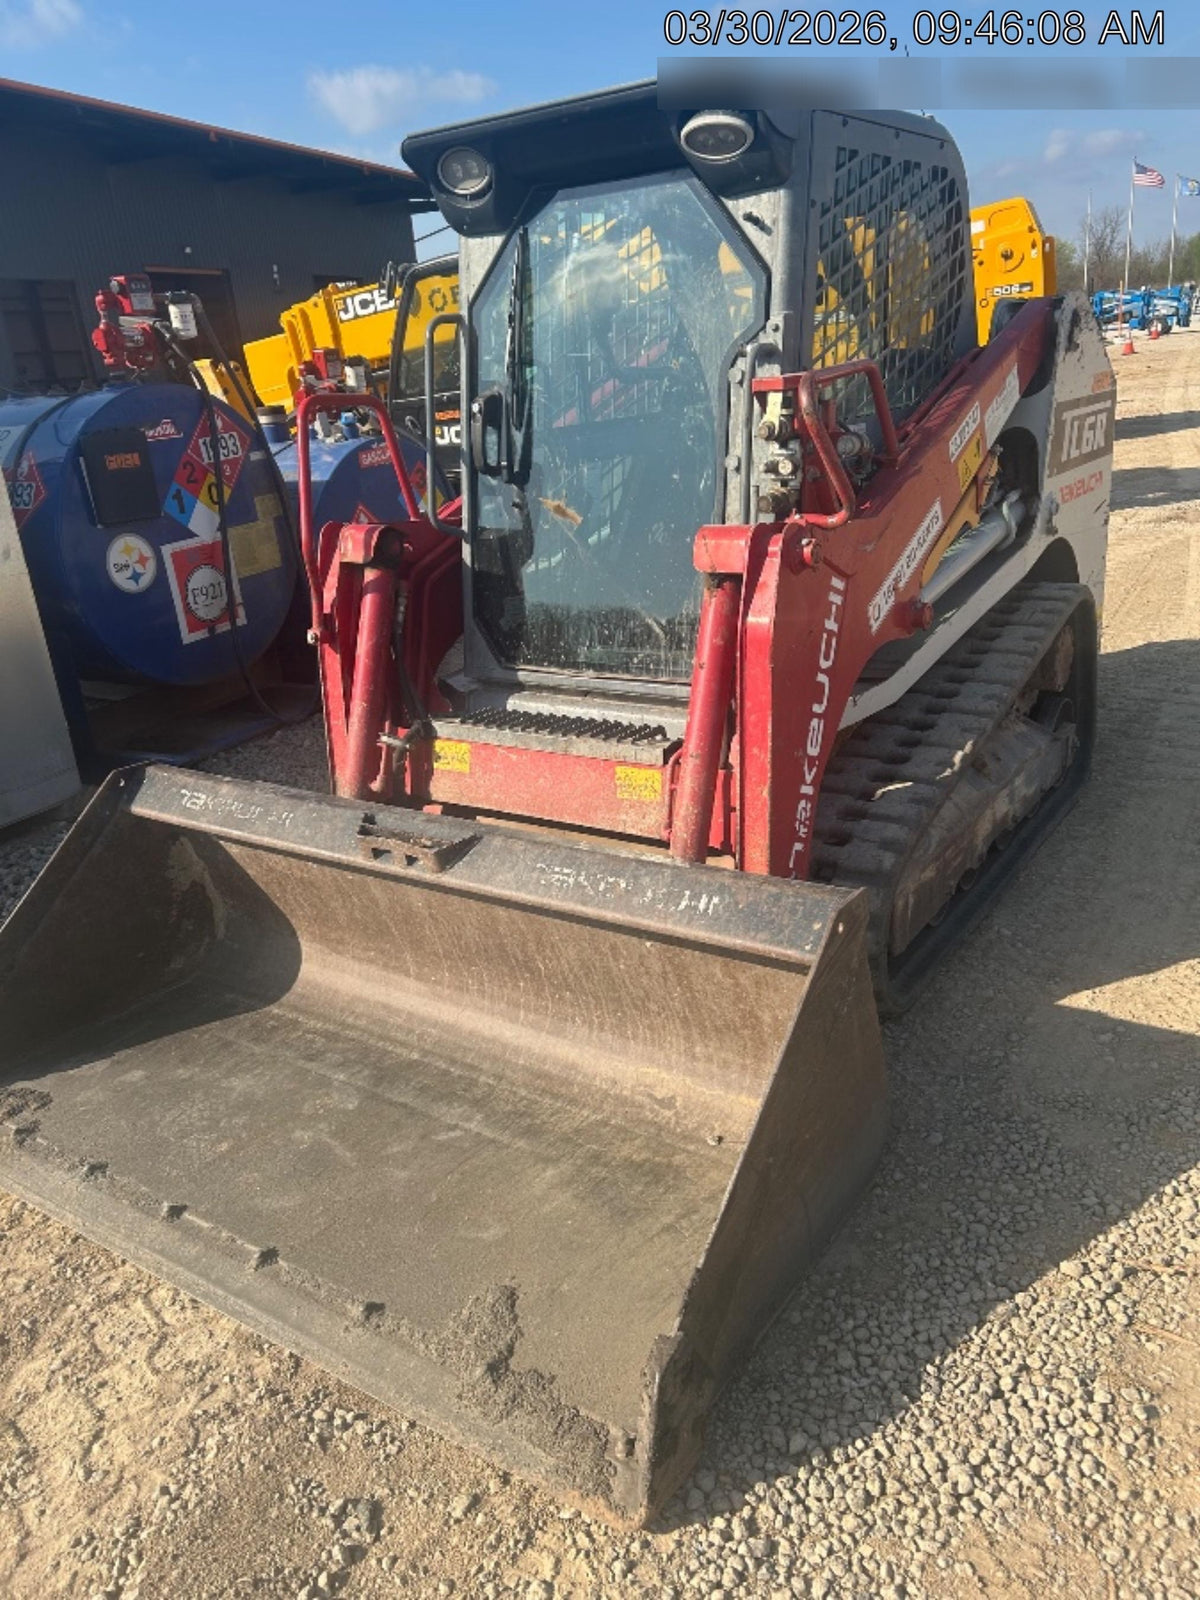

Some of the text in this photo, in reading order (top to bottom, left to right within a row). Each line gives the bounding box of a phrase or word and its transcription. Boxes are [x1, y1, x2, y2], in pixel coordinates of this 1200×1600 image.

[201, 432, 240, 463] 193
[435, 425, 461, 444] JC
[182, 461, 198, 485] 2
[171, 487, 187, 515] 1
